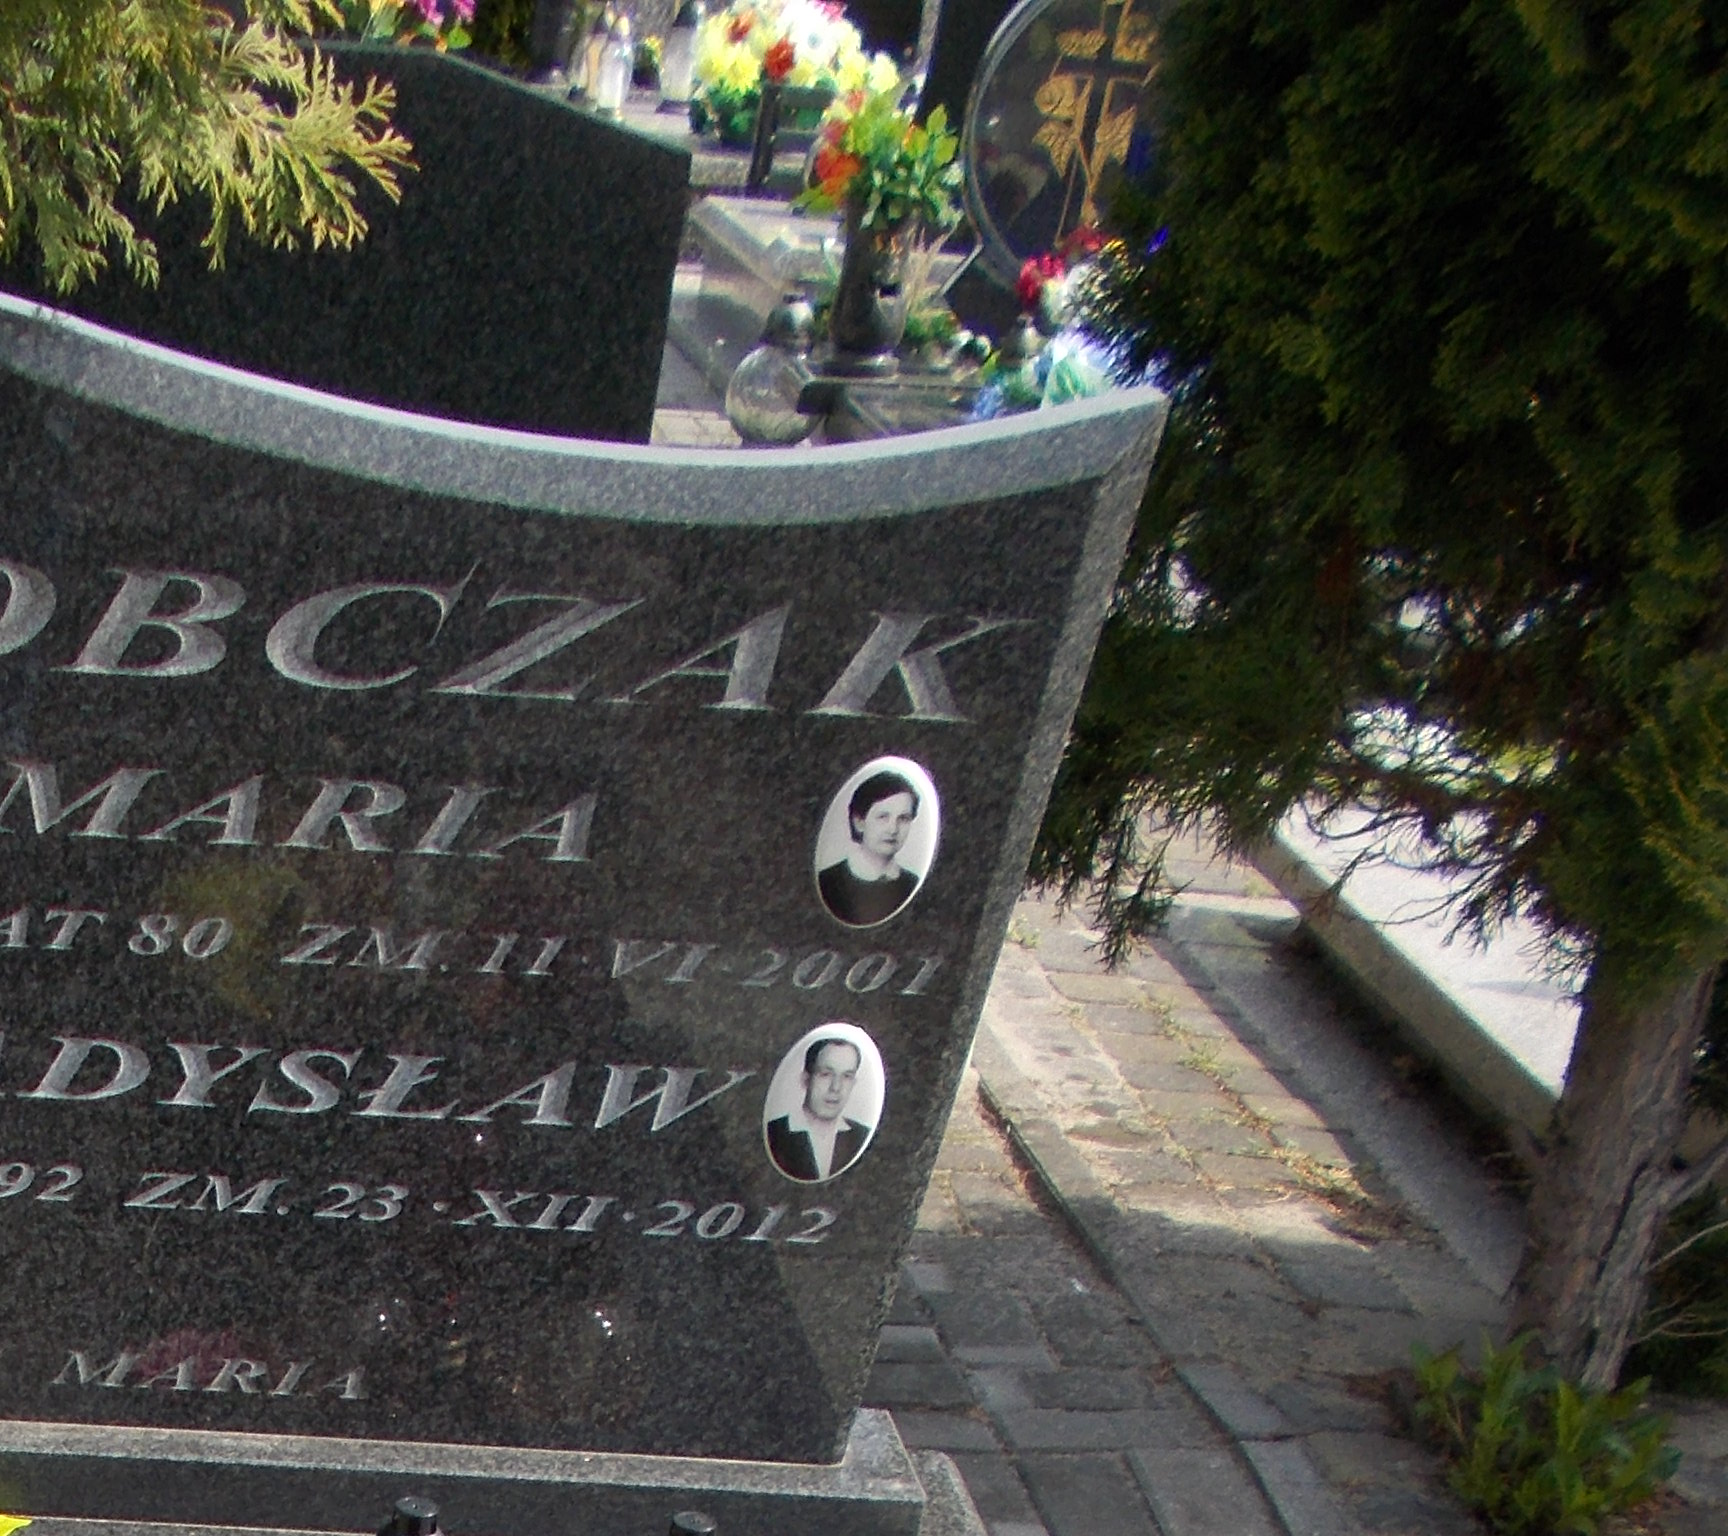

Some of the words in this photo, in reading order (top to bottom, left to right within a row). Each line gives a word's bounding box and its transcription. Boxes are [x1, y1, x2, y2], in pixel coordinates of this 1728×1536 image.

[127, 912, 234, 959] 80
[279, 922, 450, 972] ZM.
[123, 1171, 291, 1216] ZM.
[50, 1349, 368, 1400] MARIA
